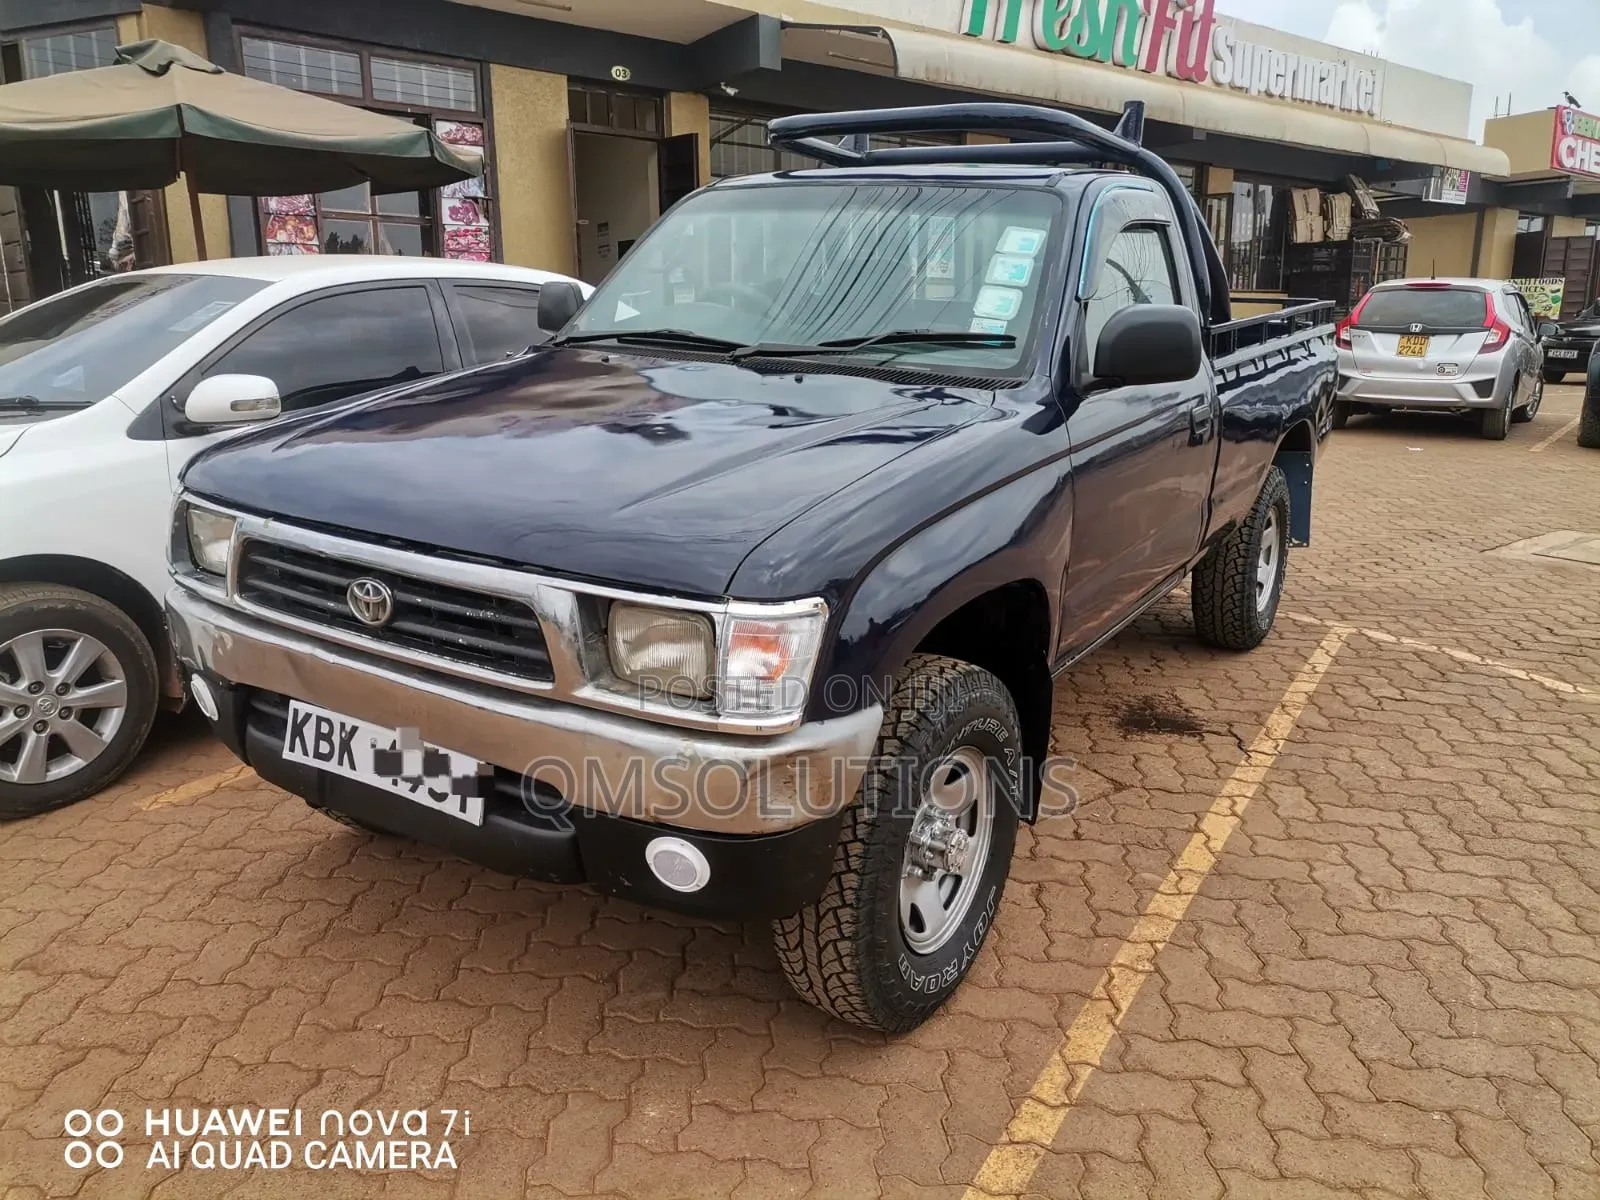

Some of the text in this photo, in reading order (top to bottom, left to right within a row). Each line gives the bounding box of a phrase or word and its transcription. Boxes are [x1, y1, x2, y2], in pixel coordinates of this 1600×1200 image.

[615, 68, 627, 79] 03
[288, 707, 360, 772] KBK
[898, 885, 997, 994] JOYROAD
